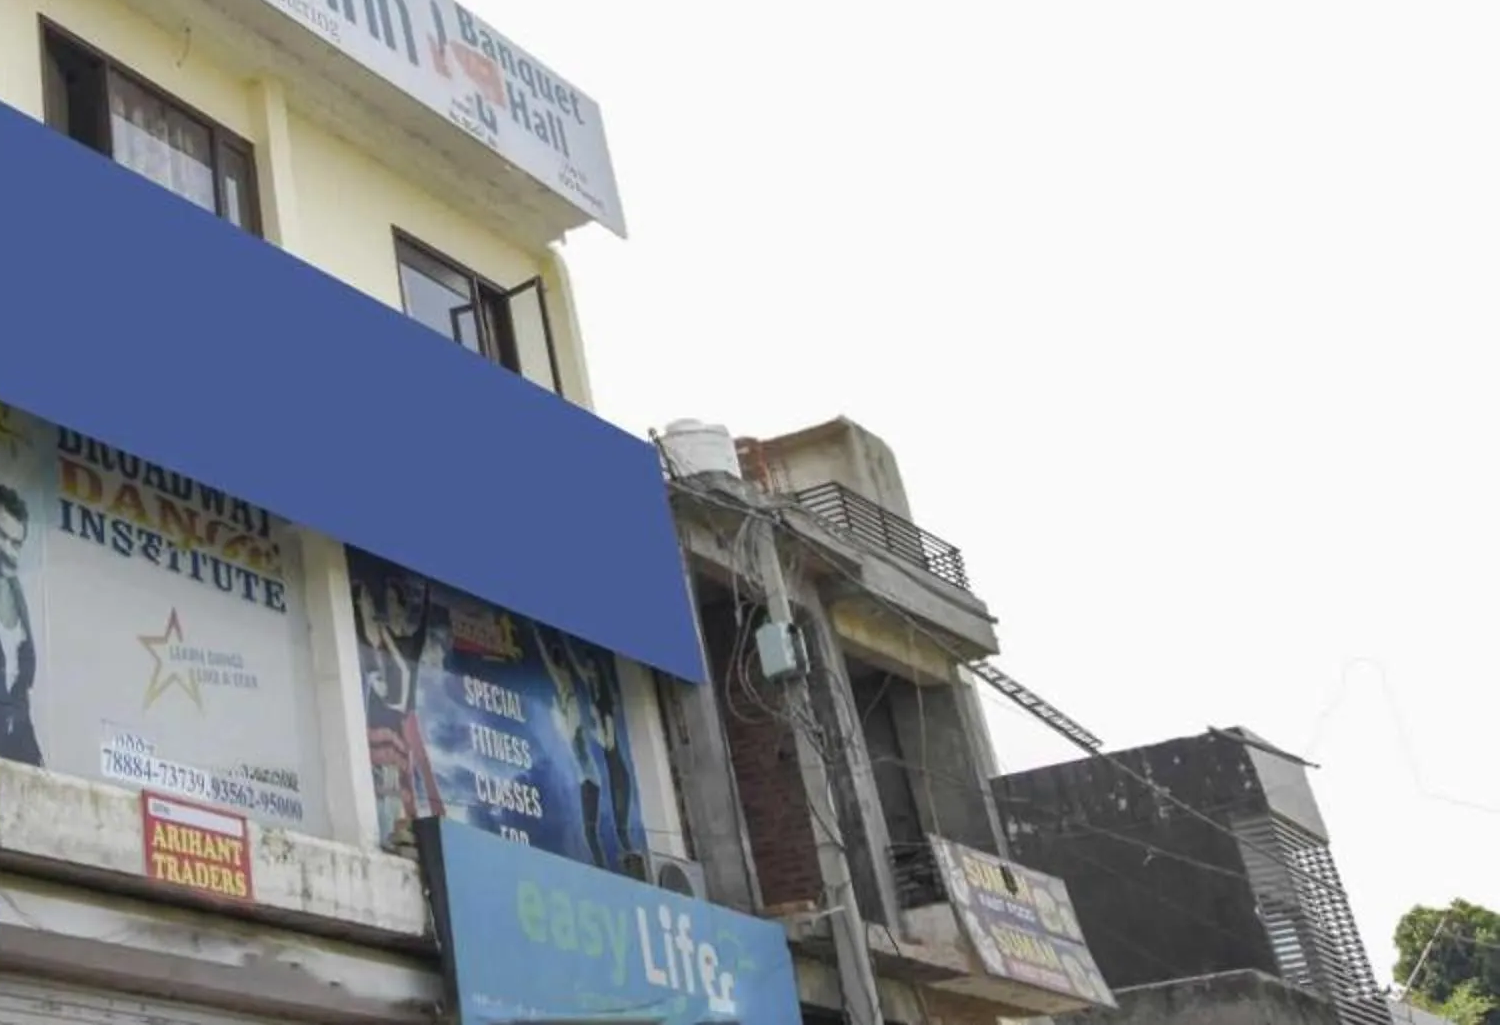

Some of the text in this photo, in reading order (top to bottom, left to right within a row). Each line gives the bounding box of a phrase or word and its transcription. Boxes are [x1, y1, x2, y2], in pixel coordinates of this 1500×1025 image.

[454, 2, 585, 125] Banquet
[507, 81, 570, 158] Hall
[464, 676, 526, 723] SPECIAL
[470, 723, 533, 770] FITNESS
[475, 771, 542, 819] CLASSES
[152, 821, 242, 867] ARIHANT
[152, 851, 248, 897] TRADERS
